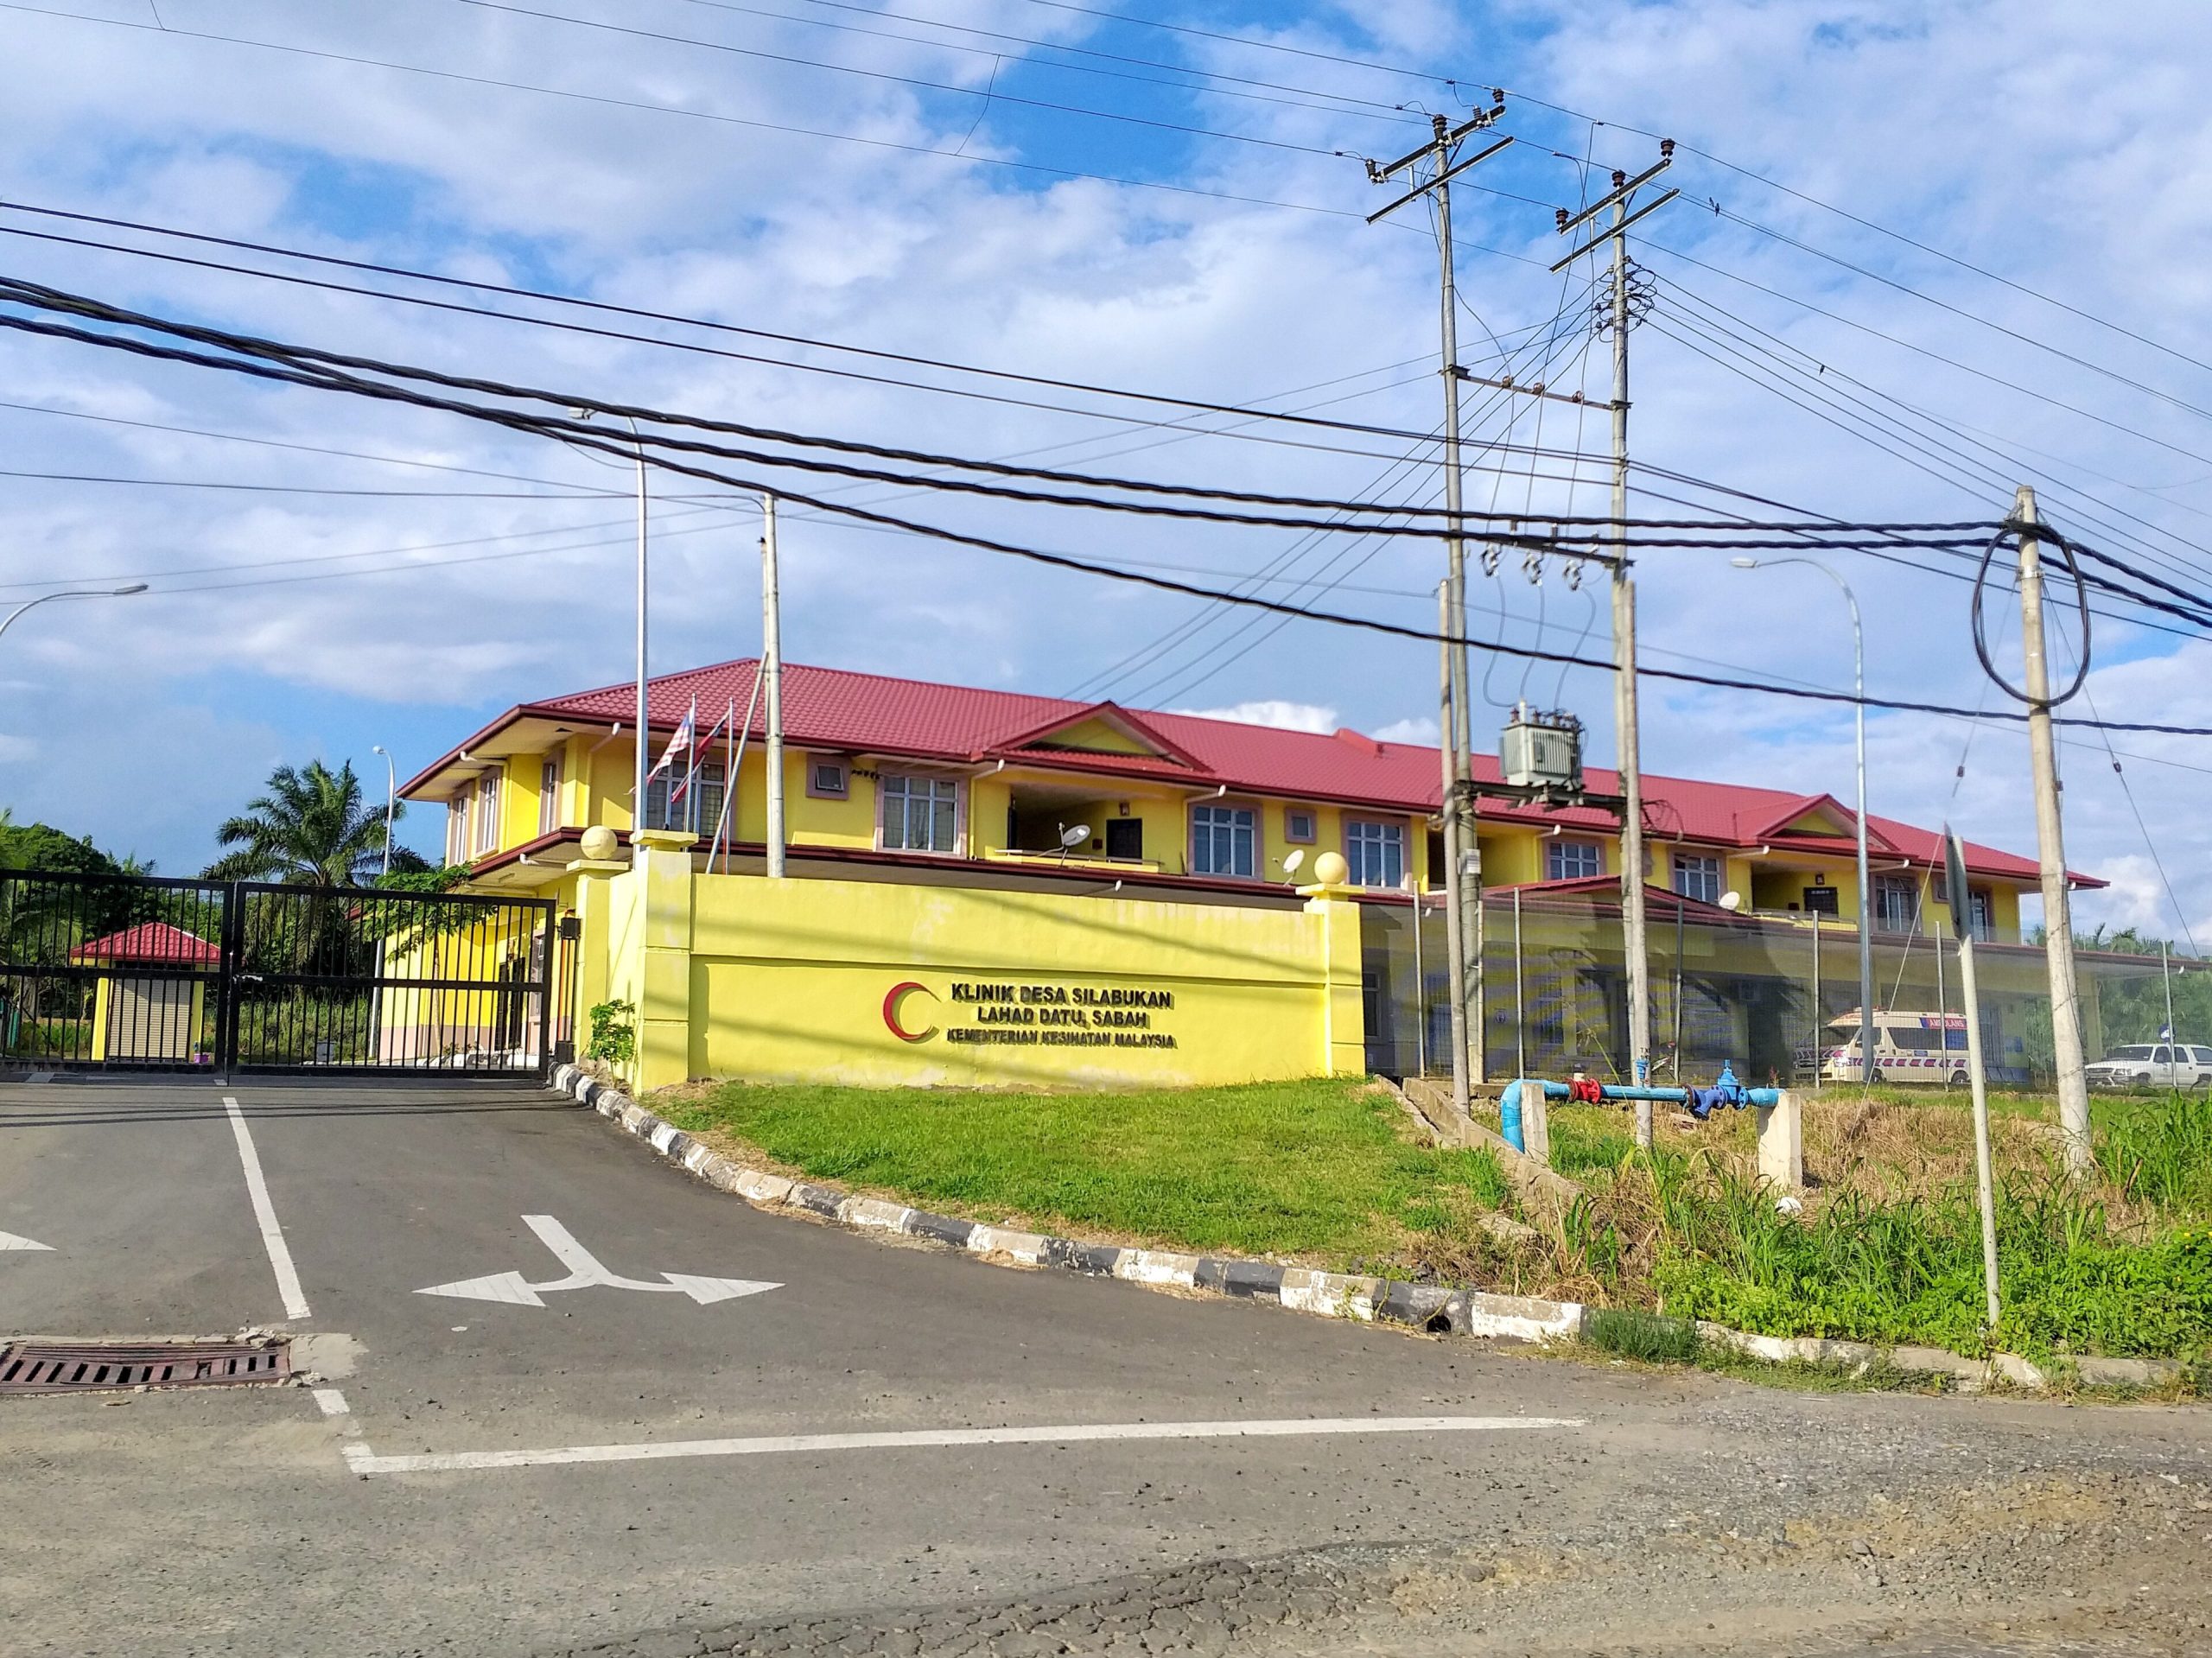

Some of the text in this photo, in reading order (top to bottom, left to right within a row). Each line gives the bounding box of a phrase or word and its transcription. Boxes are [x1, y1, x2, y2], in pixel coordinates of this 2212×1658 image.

[951, 983, 1171, 1007] KLINIK DESA SILABUKAN
[977, 1006, 1147, 1027] LAHAD DATU, SABAH
[947, 1028, 1174, 1048] KEMENTERIAN KESIHATAN MALAYSIA
